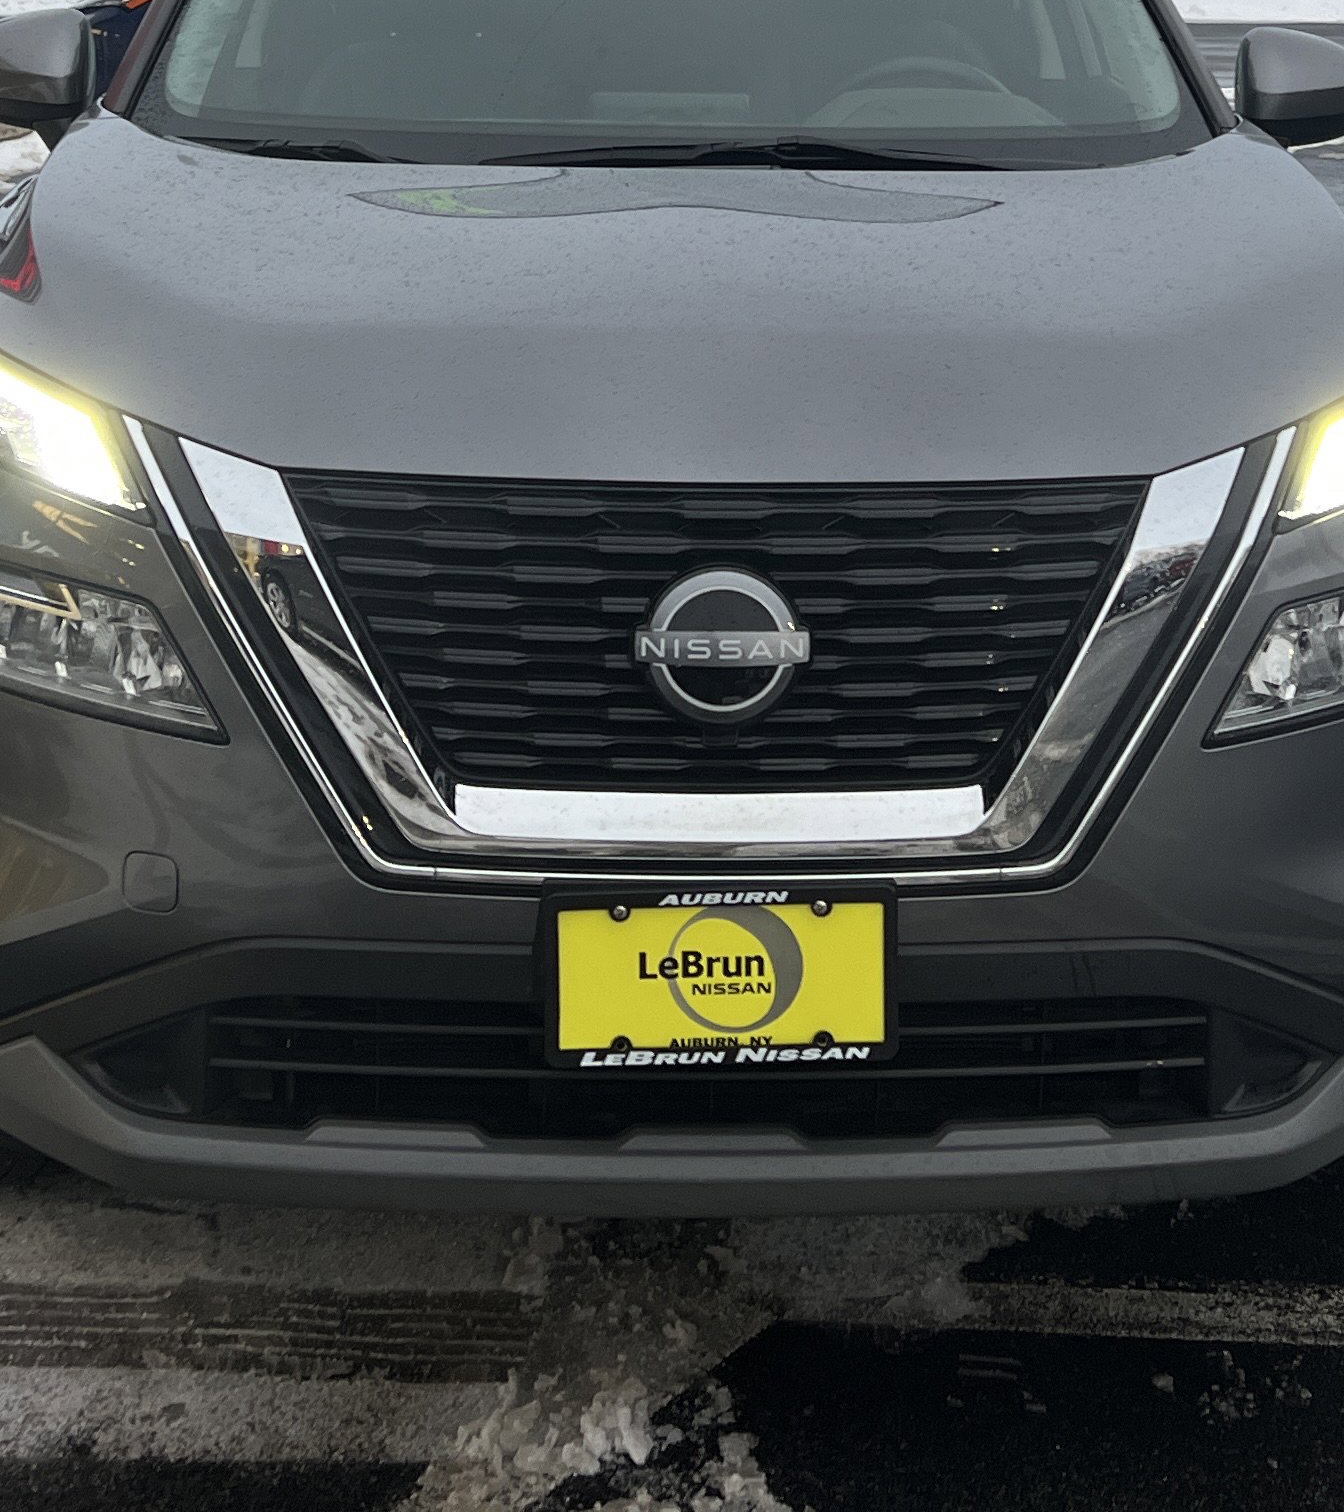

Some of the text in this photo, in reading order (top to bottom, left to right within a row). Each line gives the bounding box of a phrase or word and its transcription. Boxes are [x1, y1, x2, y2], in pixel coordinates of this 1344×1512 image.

[640, 637, 805, 660] NISSAN
[658, 891, 789, 907] AUBURN
[638, 951, 765, 980] LeBrun
[691, 982, 772, 996] NISSAN
[750, 1035, 773, 1047] NY
